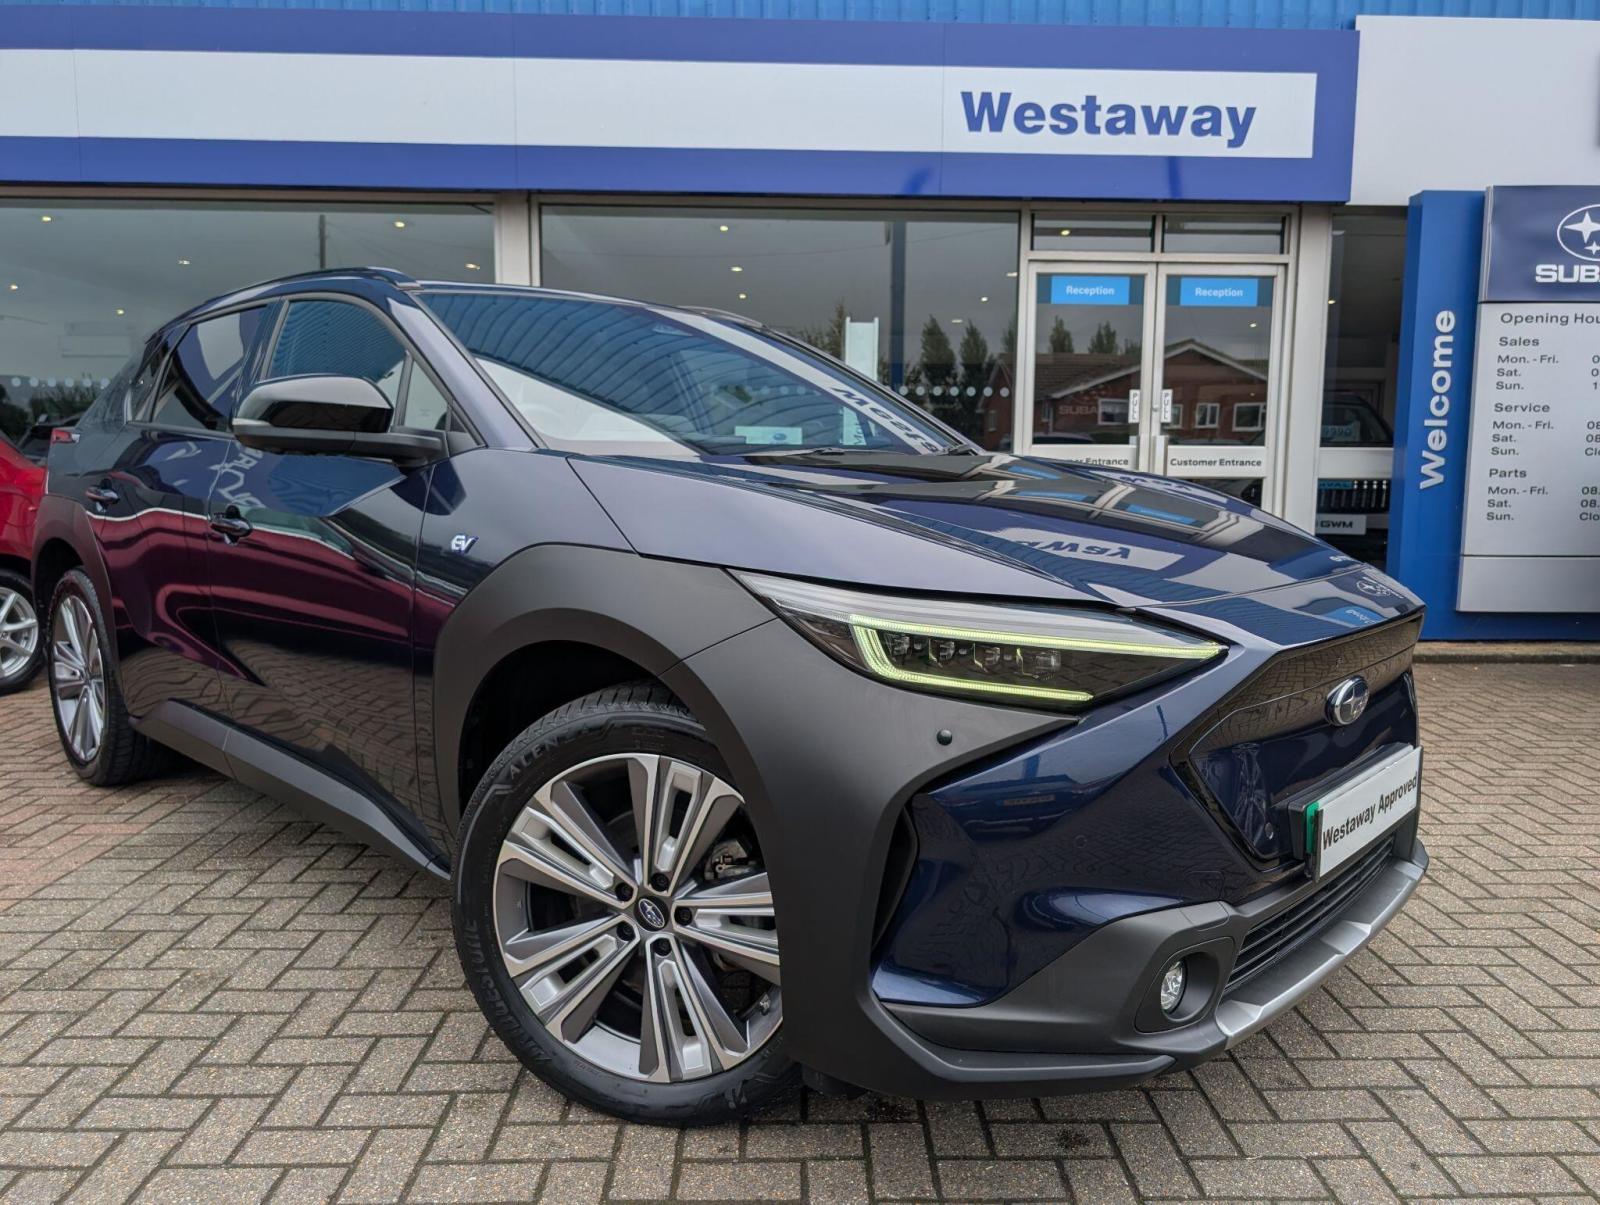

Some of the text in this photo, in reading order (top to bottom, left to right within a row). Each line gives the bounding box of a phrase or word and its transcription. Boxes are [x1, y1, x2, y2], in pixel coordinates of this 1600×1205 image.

[960, 91, 1257, 149] Westaway
[1535, 264, 1600, 283] SUB
[1066, 286, 1115, 297] Reception
[1195, 287, 1243, 298] Reception
[1500, 312, 1569, 326] Opening
[1499, 336, 1540, 347] Sales
[1497, 354, 1530, 364] Mon.
[1539, 354, 1559, 364] Fri.
[1496, 368, 1521, 377] Sat.
[1496, 381, 1524, 390] Sun.
[1419, 310, 1456, 490] Welcome
[1494, 402, 1551, 413] Service
[1492, 420, 1526, 430] Mon.
[1535, 420, 1554, 430] Fri.
[1492, 433, 1517, 443] Sat.
[1490, 446, 1519, 456] Sun.
[1170, 459, 1262, 468] Customer Entrance
[1489, 468, 1527, 478] Parts
[1487, 486, 1520, 495] Mon.
[1529, 486, 1549, 495] Fri.
[1487, 499, 1512, 508] Sat.
[1486, 512, 1515, 521] Sun.
[1320, 520, 1354, 529] GWM
[451, 534, 479, 554] EV
[1322, 771, 1418, 850] Westaway Approved
